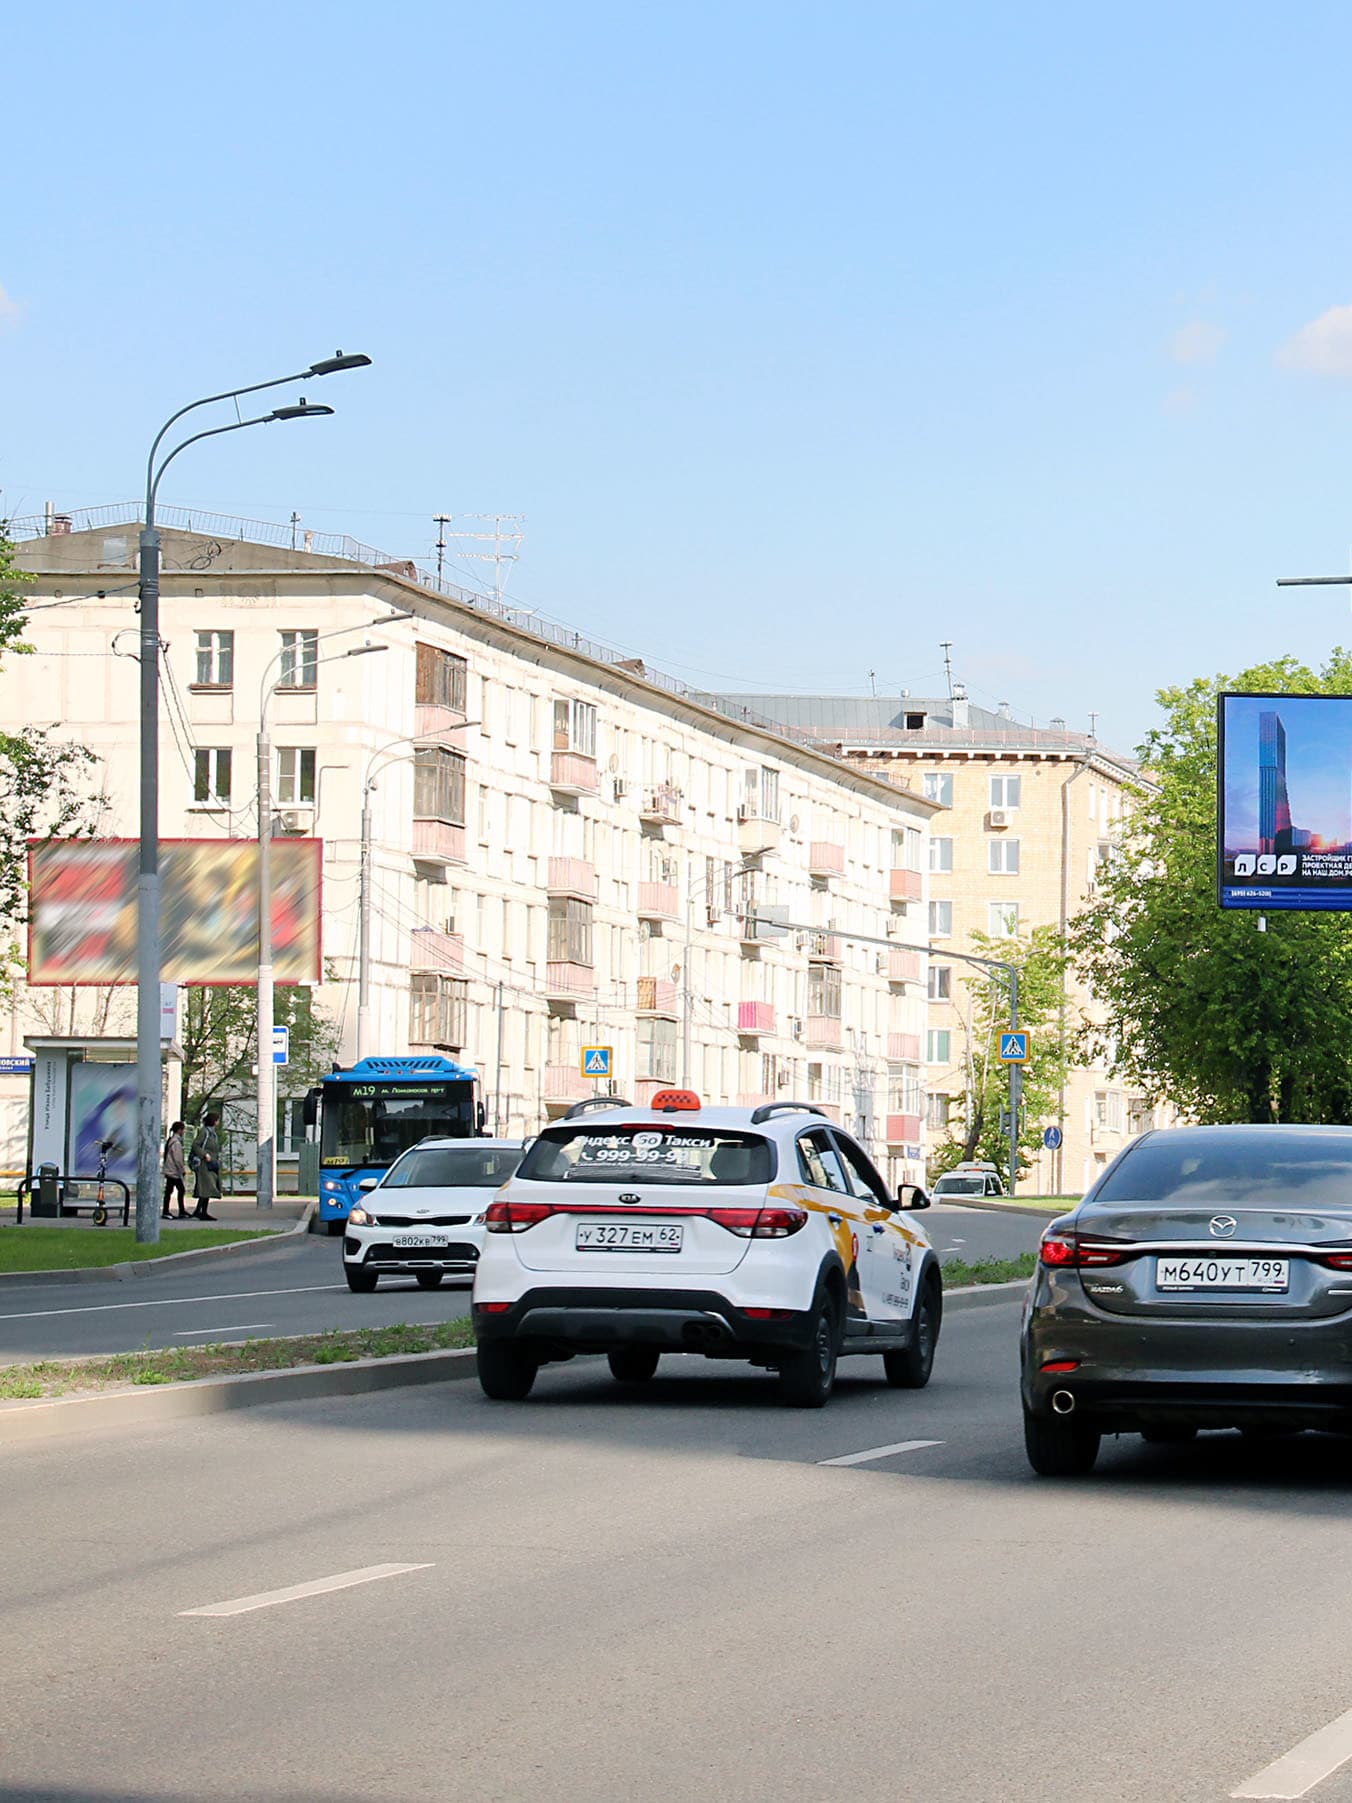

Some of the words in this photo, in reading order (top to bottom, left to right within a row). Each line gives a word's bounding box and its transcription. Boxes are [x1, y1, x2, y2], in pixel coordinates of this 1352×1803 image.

[575, 1135, 631, 1147] ндекс
[665, 1133, 711, 1148] Такси
[659, 1228, 677, 1241] 62
[1251, 1261, 1283, 1278] 799
